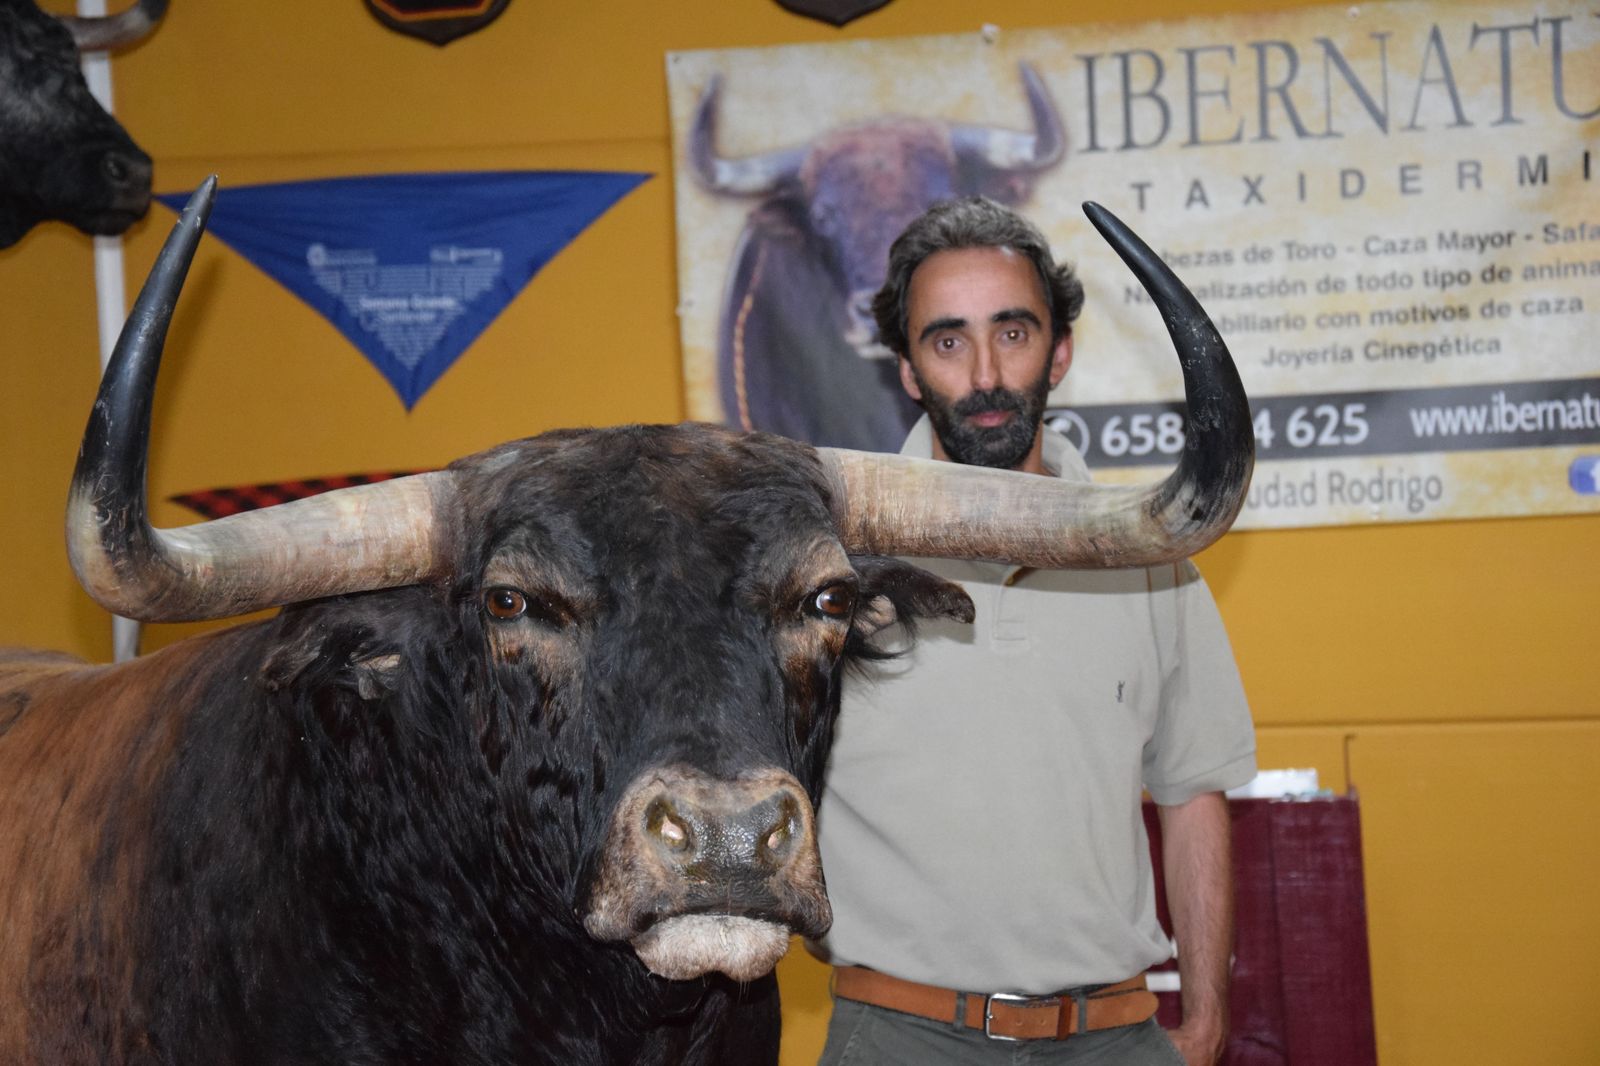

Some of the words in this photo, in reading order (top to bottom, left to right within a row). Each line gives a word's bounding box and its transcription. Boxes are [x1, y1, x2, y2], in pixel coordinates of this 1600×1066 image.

[1075, 13, 1600, 154] IBERNATU
[1131, 150, 1591, 211] TAXIDERMI
[1160, 247, 1235, 267] bezas
[1244, 244, 1273, 263] de
[1282, 240, 1337, 261] Toro
[1363, 234, 1427, 256] Caza
[1437, 230, 1516, 254] Mayor
[1124, 277, 1307, 303] Nalización
[1316, 273, 1347, 294] de
[1356, 271, 1414, 291] todo
[1423, 268, 1472, 291] tipo
[1480, 264, 1512, 284] de
[1219, 312, 1307, 333] biliario
[1316, 310, 1361, 330] con
[1370, 303, 1471, 326] motivos
[1480, 298, 1512, 318] de
[1521, 296, 1584, 317] caza
[1262, 341, 1354, 369] Joyería
[1363, 337, 1503, 363] Cinegética
[1101, 411, 1186, 457] 658
[1286, 403, 1370, 448] 625
[1246, 471, 1317, 510] udad
[1328, 465, 1443, 513] Rodrigo
